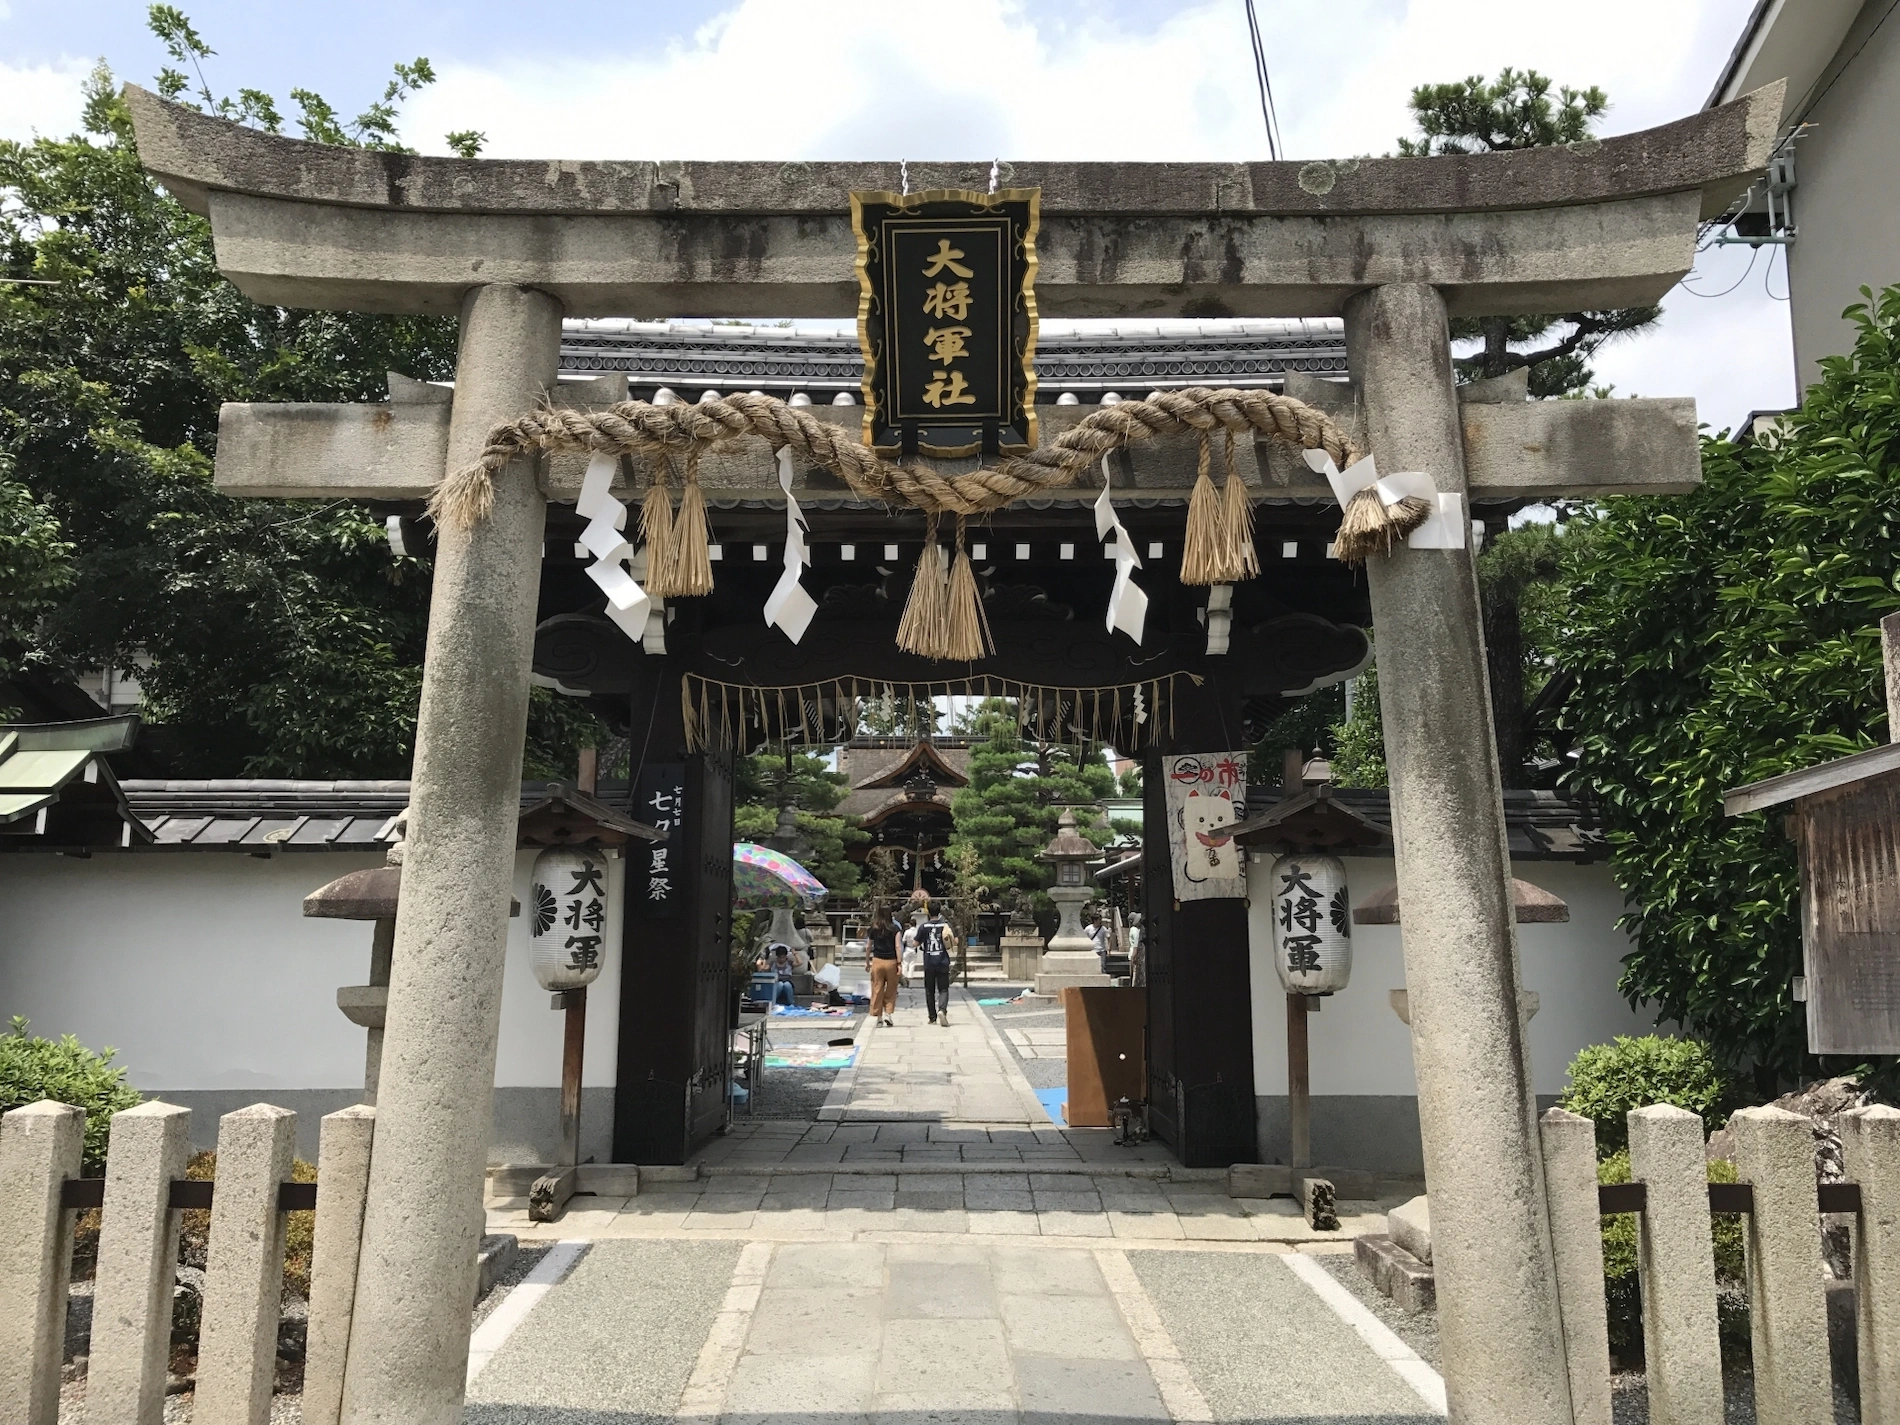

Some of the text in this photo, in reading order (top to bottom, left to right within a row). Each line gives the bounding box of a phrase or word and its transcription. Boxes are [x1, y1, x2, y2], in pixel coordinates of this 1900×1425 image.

[922, 238, 976, 408] 大将軍社
[672, 785, 683, 827] 七月七日
[1171, 758, 1239, 788] 一の市
[563, 860, 606, 975] 大将軍
[1277, 863, 1325, 977] 大将軍
